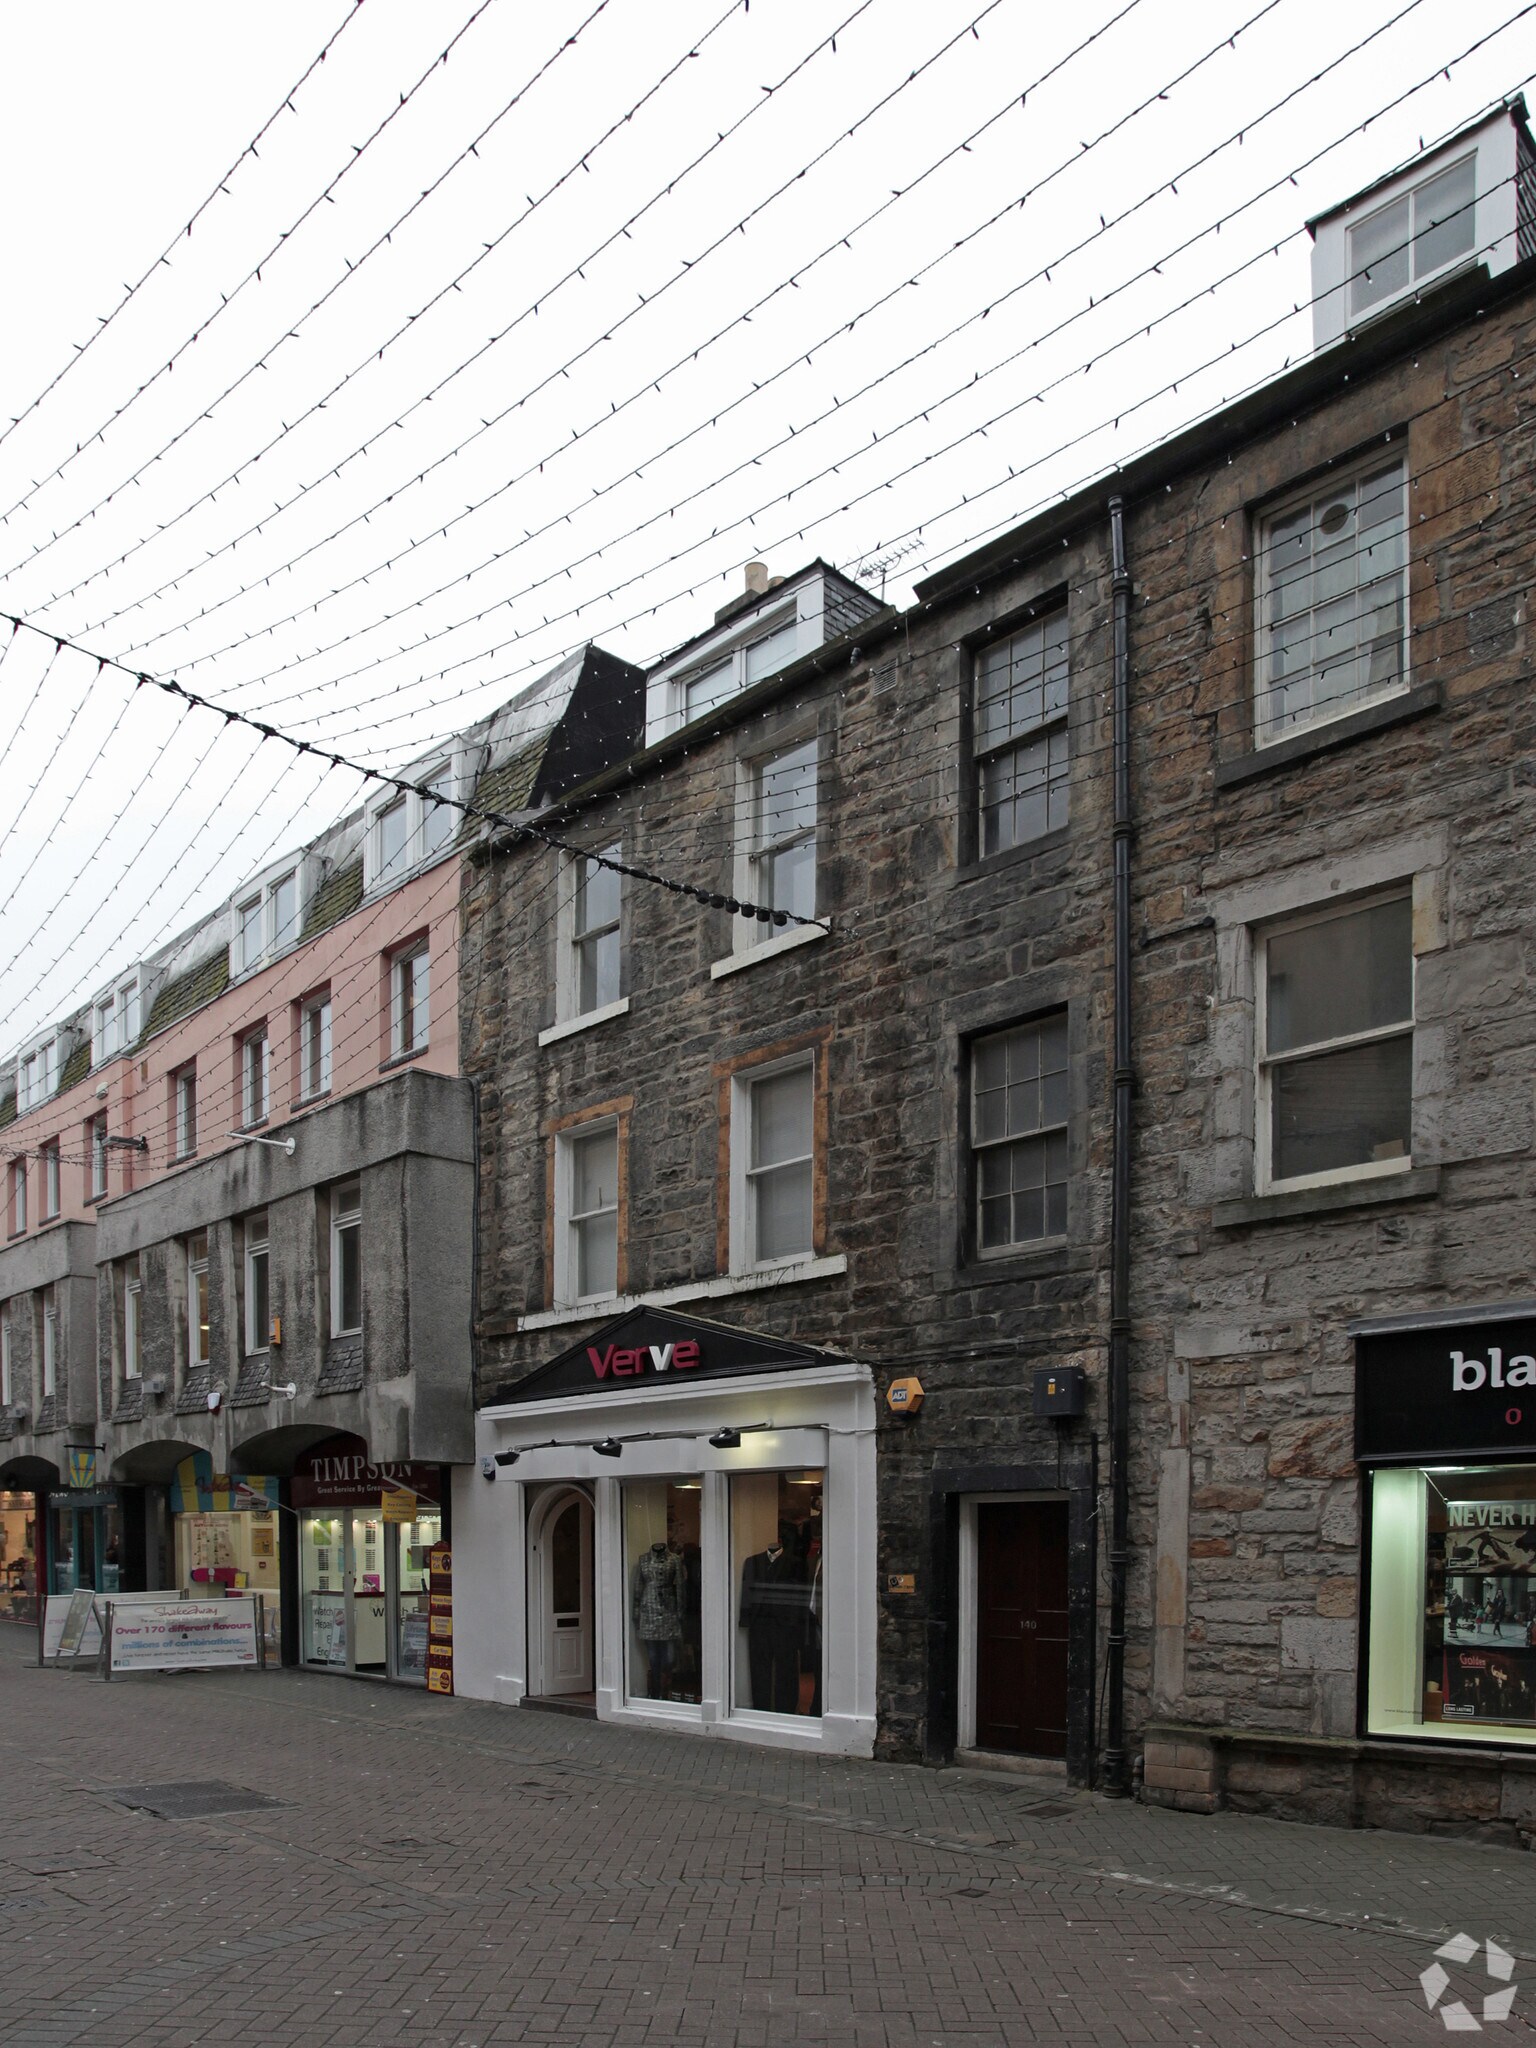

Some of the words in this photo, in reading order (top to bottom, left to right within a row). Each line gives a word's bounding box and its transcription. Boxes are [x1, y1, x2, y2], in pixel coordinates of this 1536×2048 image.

[587, 1341, 700, 1378] Verve
[1449, 1347, 1536, 1391] bla
[892, 1390, 907, 1401] ADT
[317, 1486, 333, 1494] Great
[334, 1485, 356, 1494] Service
[357, 1485, 365, 1493] By
[1449, 1505, 1515, 1527] NEVER
[314, 1607, 333, 1617] Watch
[115, 1627, 141, 1635] Over
[145, 1626, 165, 1634] 170
[168, 1623, 210, 1633] different
[213, 1622, 252, 1631] flavours
[1020, 1620, 1037, 1630] 140
[121, 1640, 160, 1650] millions
[162, 1640, 174, 1648] of
[1459, 1653, 1486, 1666] Golden
